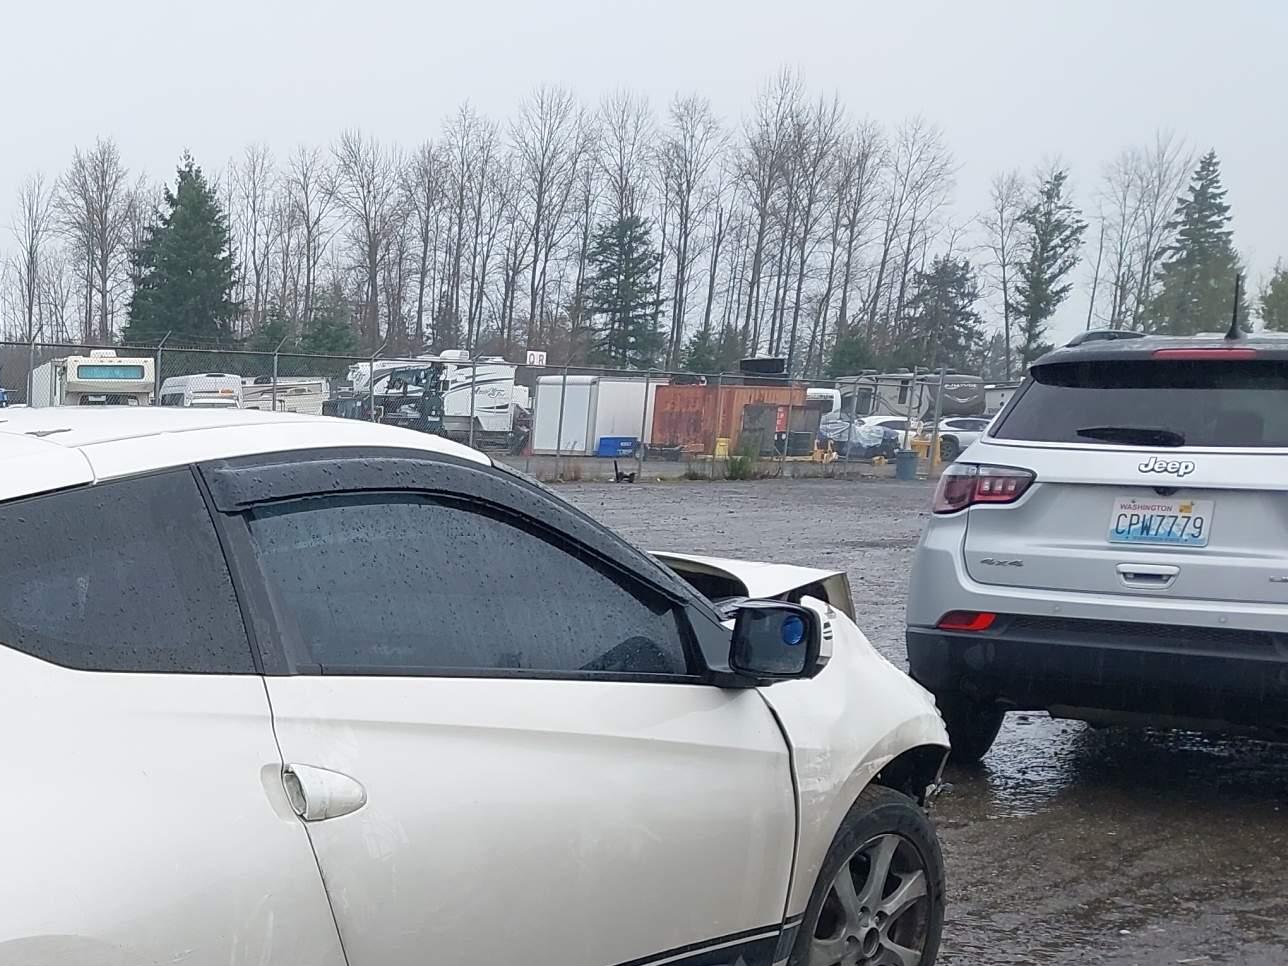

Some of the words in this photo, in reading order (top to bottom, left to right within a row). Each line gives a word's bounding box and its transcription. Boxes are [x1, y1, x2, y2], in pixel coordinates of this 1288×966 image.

[1138, 456, 1195, 477] Jeep
[1120, 503, 1173, 512] WASHINGTON
[1115, 513, 1204, 539] CPW7779
